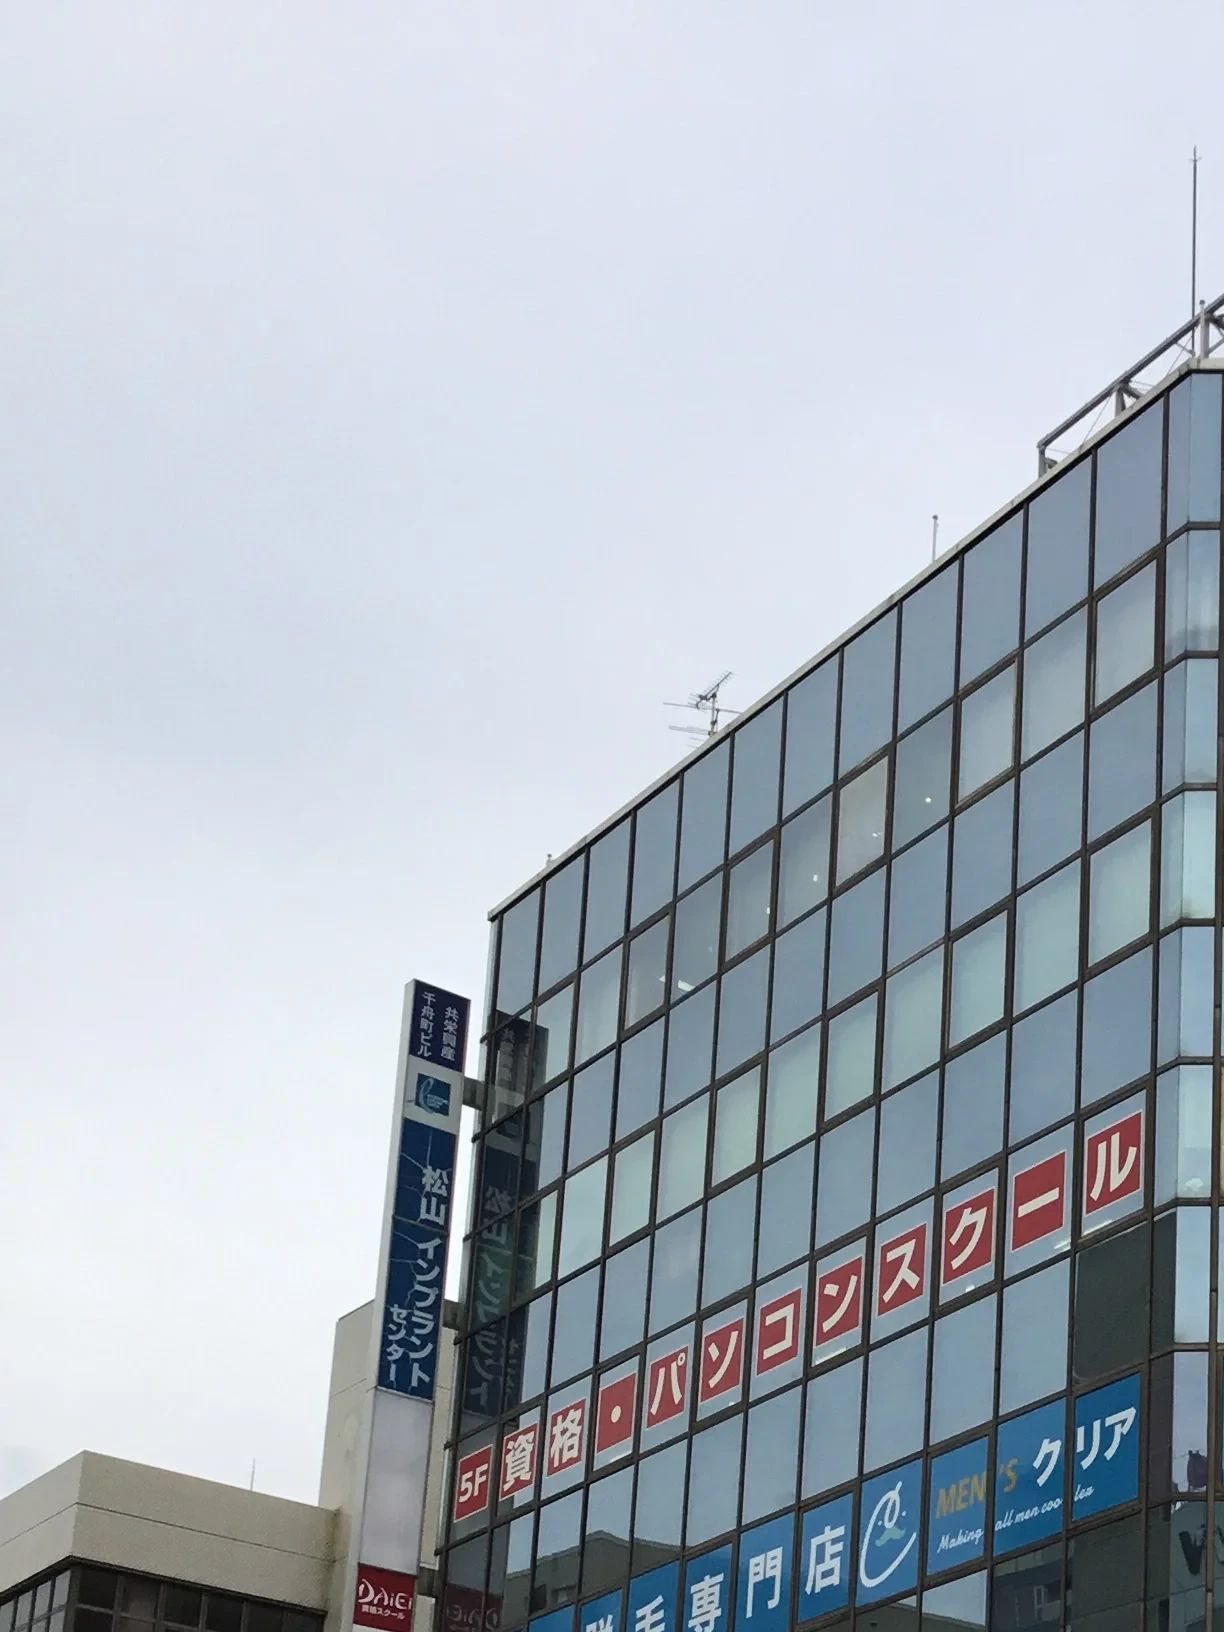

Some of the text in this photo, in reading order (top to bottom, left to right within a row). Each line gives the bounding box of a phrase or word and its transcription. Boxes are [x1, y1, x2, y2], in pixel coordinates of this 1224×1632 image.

[417, 990, 436, 1057] 千舟町ビル
[440, 1005, 459, 1063] 共栄興産
[384, 1304, 409, 1384] センター
[1032, 1406, 1136, 1487] クリア
[458, 1463, 488, 1503] 5F
[937, 1527, 984, 1554] Making
[995, 1510, 1014, 1531] all
